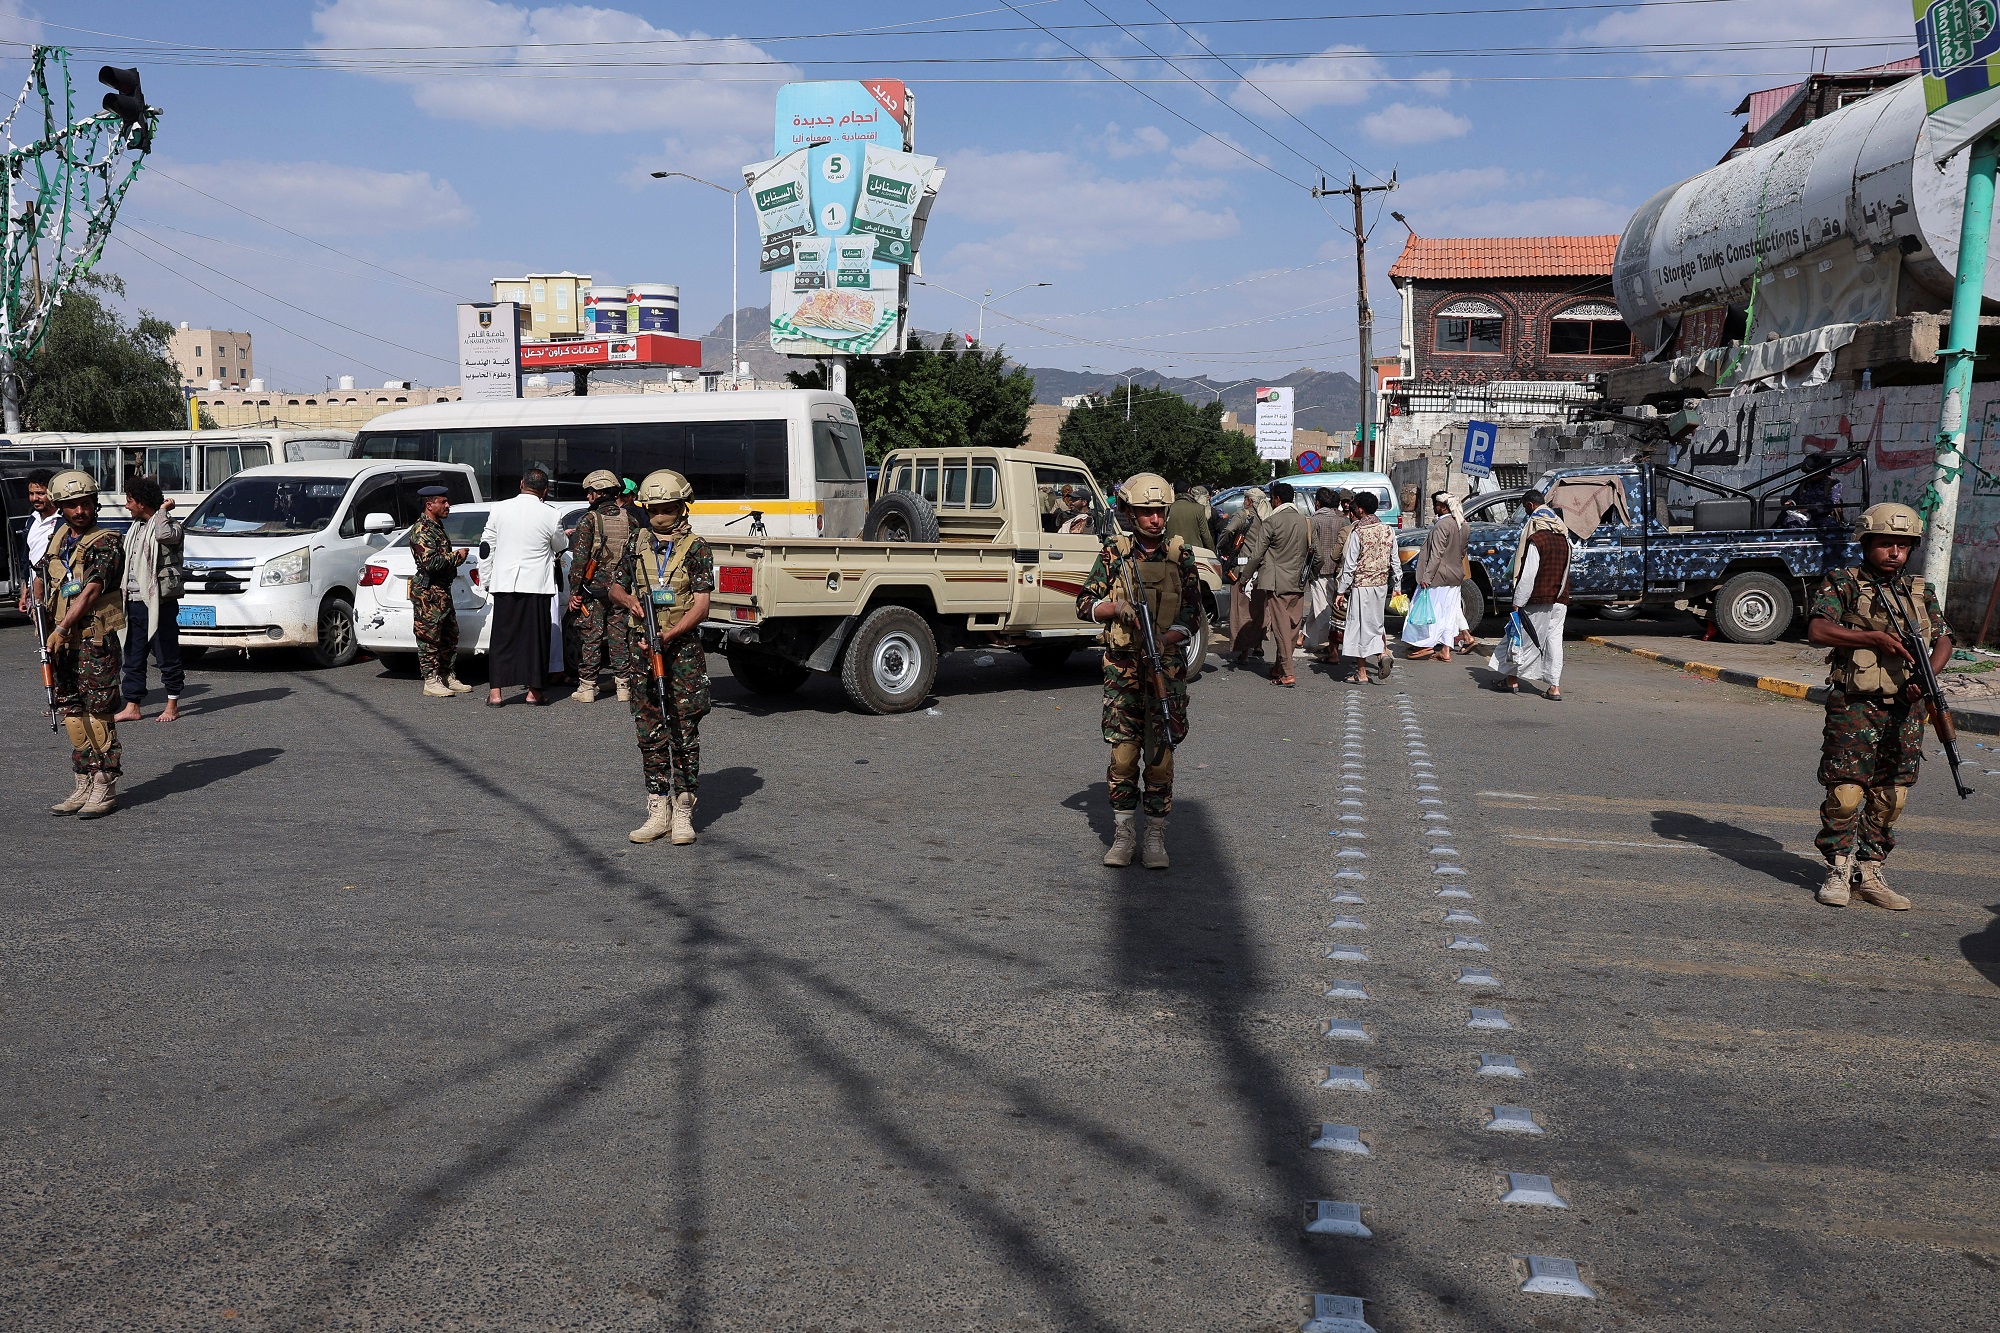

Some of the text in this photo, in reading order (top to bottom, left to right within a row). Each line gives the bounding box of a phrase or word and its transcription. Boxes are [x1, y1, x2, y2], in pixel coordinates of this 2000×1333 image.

[872, 84, 898, 111] جديد
[793, 107, 878, 129] أحجام جديدة
[830, 156, 842, 173] 5
[869, 178, 907, 196] السنابل
[759, 186, 794, 207] السنابل
[828, 206, 835, 221] 1
[1662, 260, 1697, 284] Storage
[1696, 248, 1725, 273] Tanks
[485, 330, 505, 338] جامعة
[465, 357, 511, 367] كلية الهندسة
[524, 349, 544, 358] نجعل
[465, 371, 511, 380] وعلوم الحاسوب
[1469, 430, 1490, 463] P
